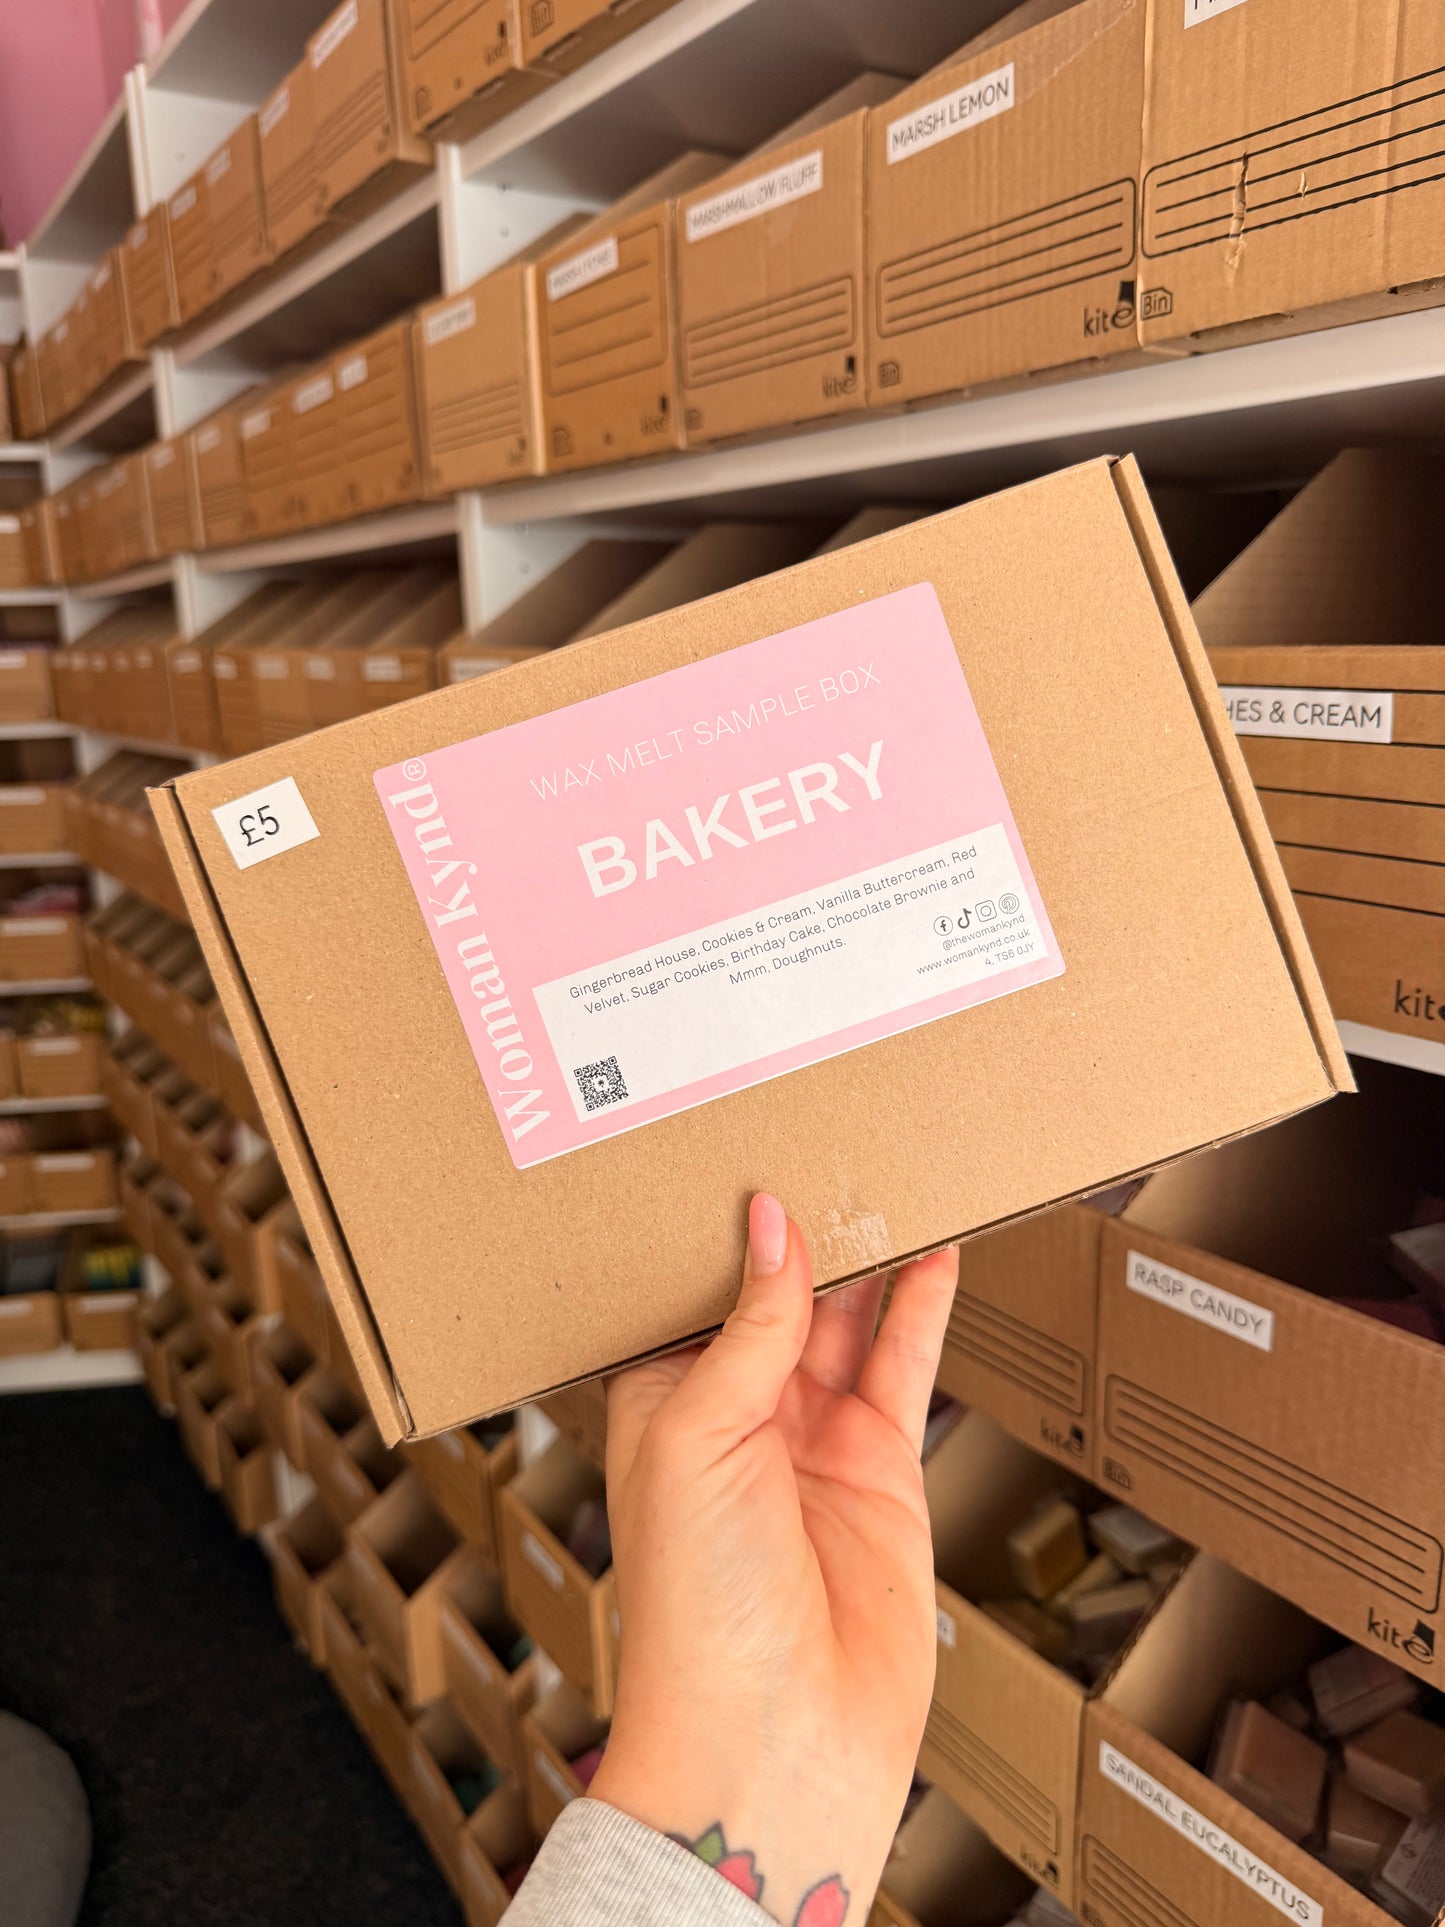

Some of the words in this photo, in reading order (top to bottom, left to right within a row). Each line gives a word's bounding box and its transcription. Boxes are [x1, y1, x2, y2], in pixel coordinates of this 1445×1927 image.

[890, 109, 946, 150] MARSH
[948, 77, 1009, 124] LEMON
[1083, 298, 1136, 338] kite
[1143, 294, 1169, 316] Bin
[530, 759, 602, 801] WAX
[606, 728, 686, 777] MELT
[693, 685, 815, 745] SAMPLE
[819, 662, 881, 702] BOX
[1226, 699, 1262, 722] HES
[1268, 701, 1285, 724] &
[1293, 702, 1382, 729] CREAM
[239, 804, 280, 847] £5
[577, 740, 884, 898] BAKERY
[569, 960, 652, 999] Gingerbread
[654, 946, 701, 969] House,
[702, 927, 754, 952] Cookies
[755, 921, 766, 934] &
[767, 905, 816, 930] Cream,
[815, 887, 861, 911] Vanilla
[863, 857, 951, 895] Buttercream,
[951, 845, 977, 864] Red
[584, 992, 630, 1014] Velvet,
[631, 977, 671, 999] Sugar
[674, 959, 730, 984] Cookies,
[731, 936, 786, 964] Birthday
[788, 921, 826, 943] Cake,
[827, 899, 892, 929] Chocolate
[894, 878, 949, 906] Brownie
[951, 867, 976, 886] and
[942, 914, 1026, 951] @thewomankynd
[729, 964, 771, 986] Mmm,
[773, 938, 847, 971] Doughnuts.
[916, 929, 1031, 976] www.womankynd.co.uk
[995, 948, 1015, 962] TS6
[1394, 978, 1445, 1022] kit
[457, 932, 551, 1143] Woman
[1134, 1262, 1186, 1297] RASP
[1189, 1288, 1264, 1335] CANDY
[1367, 1606, 1435, 1665] kite
[1104, 1753, 1177, 1819] SANDAL
[1181, 1810, 1311, 1921] EUCALYPTUS
